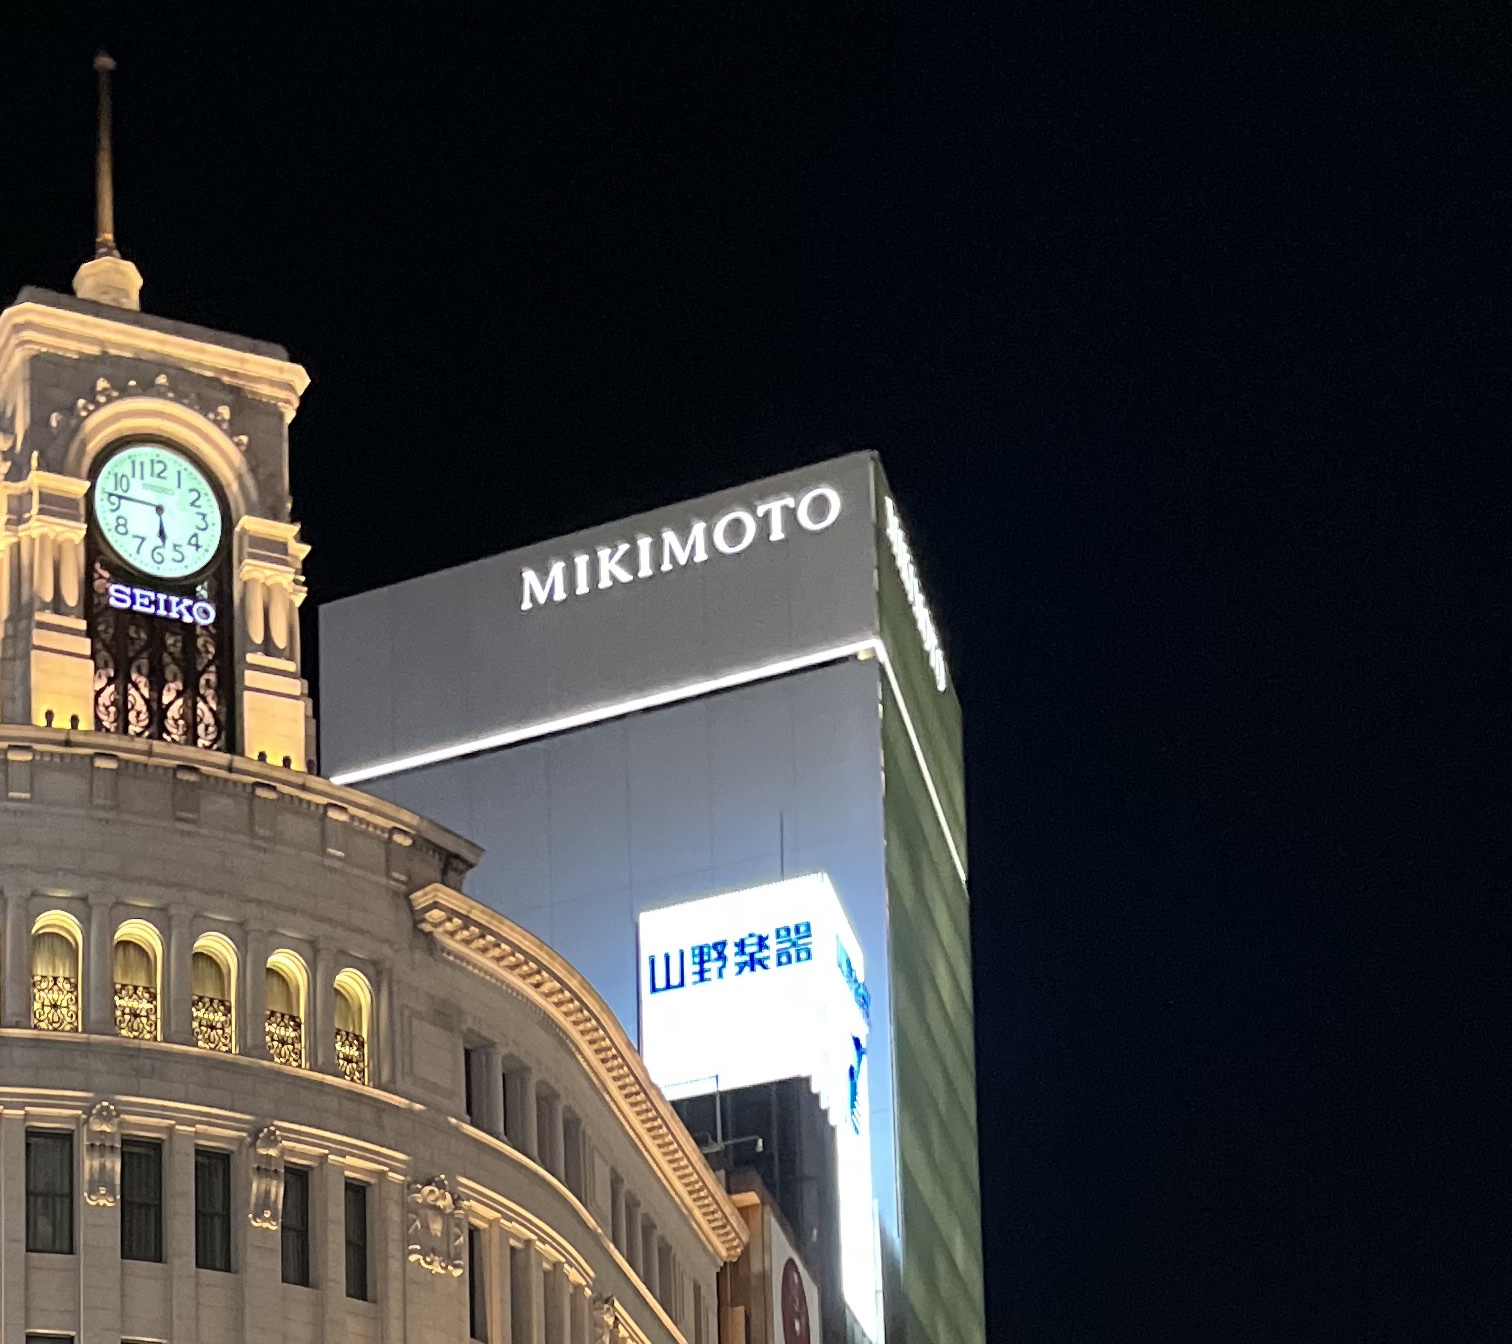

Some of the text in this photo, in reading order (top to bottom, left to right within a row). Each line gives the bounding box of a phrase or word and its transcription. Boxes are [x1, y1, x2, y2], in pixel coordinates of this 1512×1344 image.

[131, 460, 145, 480] 11
[150, 459, 167, 480] 12
[176, 470, 182, 489] 1
[113, 472, 130, 493] 10
[107, 494, 122, 512] 9
[189, 489, 202, 509] 2
[115, 515, 128, 536] 8
[195, 511, 208, 532] 3
[132, 535, 147, 555] 7
[187, 532, 202, 552] 4
[520, 484, 842, 612] MIKIMOTO
[151, 545, 165, 565] 6
[172, 544, 185, 563] 5
[108, 583, 216, 627] SEIKO
[648, 920, 813, 994] 山野楽器
